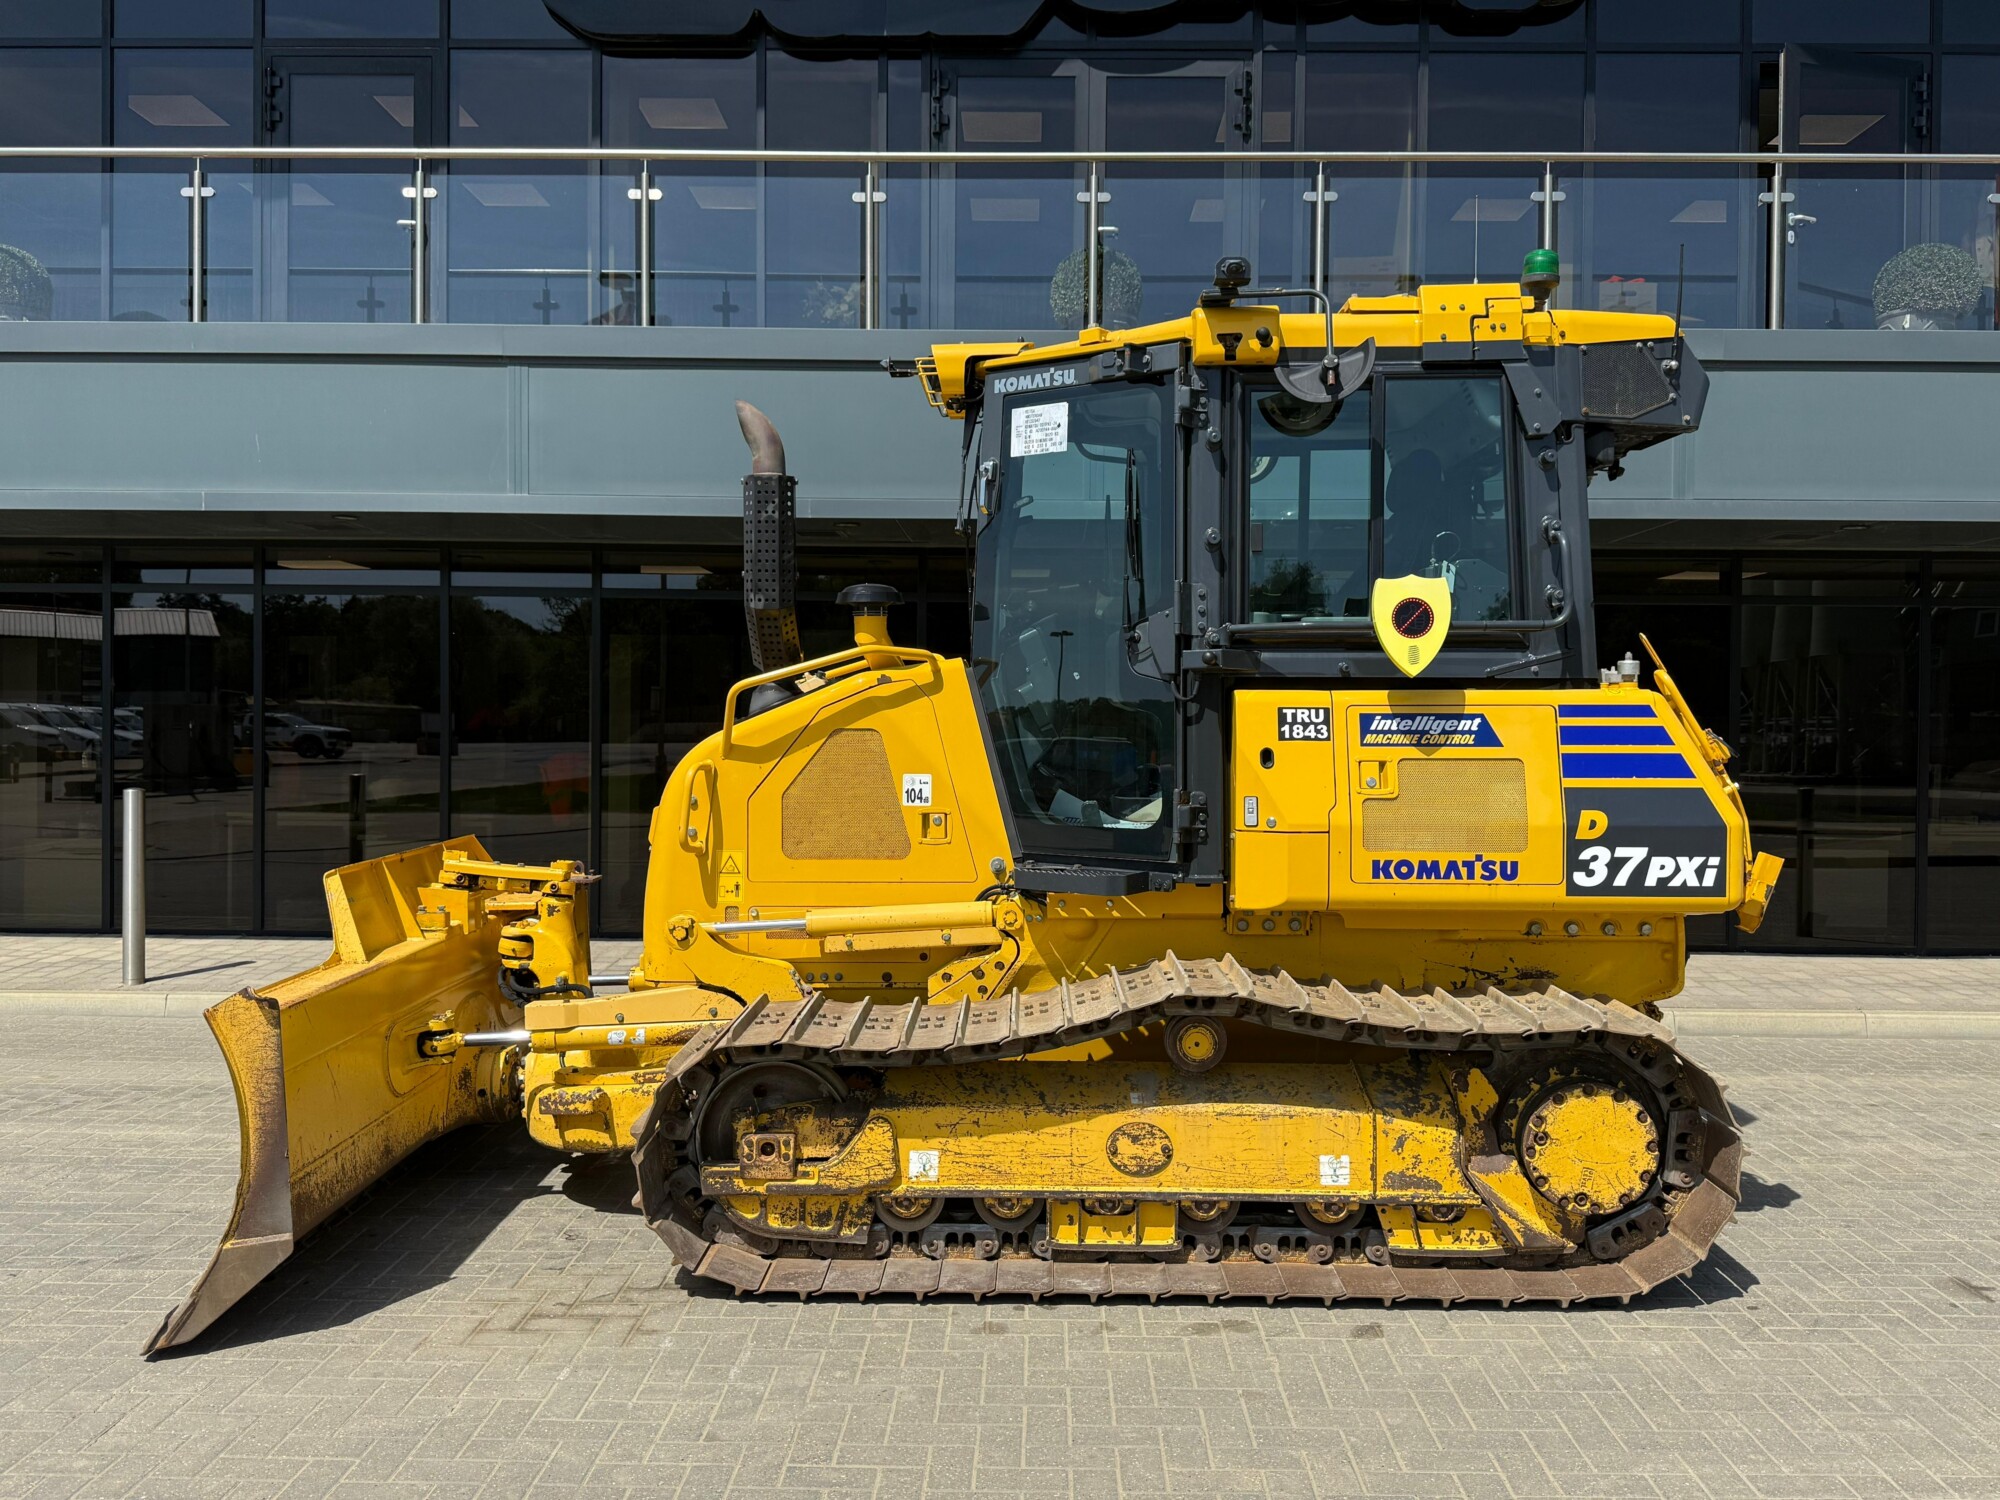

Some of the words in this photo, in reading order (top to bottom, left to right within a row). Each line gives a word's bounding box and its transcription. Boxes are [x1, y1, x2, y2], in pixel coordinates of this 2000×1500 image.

[994, 368, 1074, 394] KOMATSU
[1283, 709, 1325, 723] TRU
[1370, 716, 1482, 734] intelligent
[1280, 724, 1329, 739] 1843
[1363, 734, 1420, 744] MACHINE
[1421, 734, 1476, 744] CONTROL
[1575, 809, 1609, 840] D
[1372, 854, 1519, 881] KOMATSU
